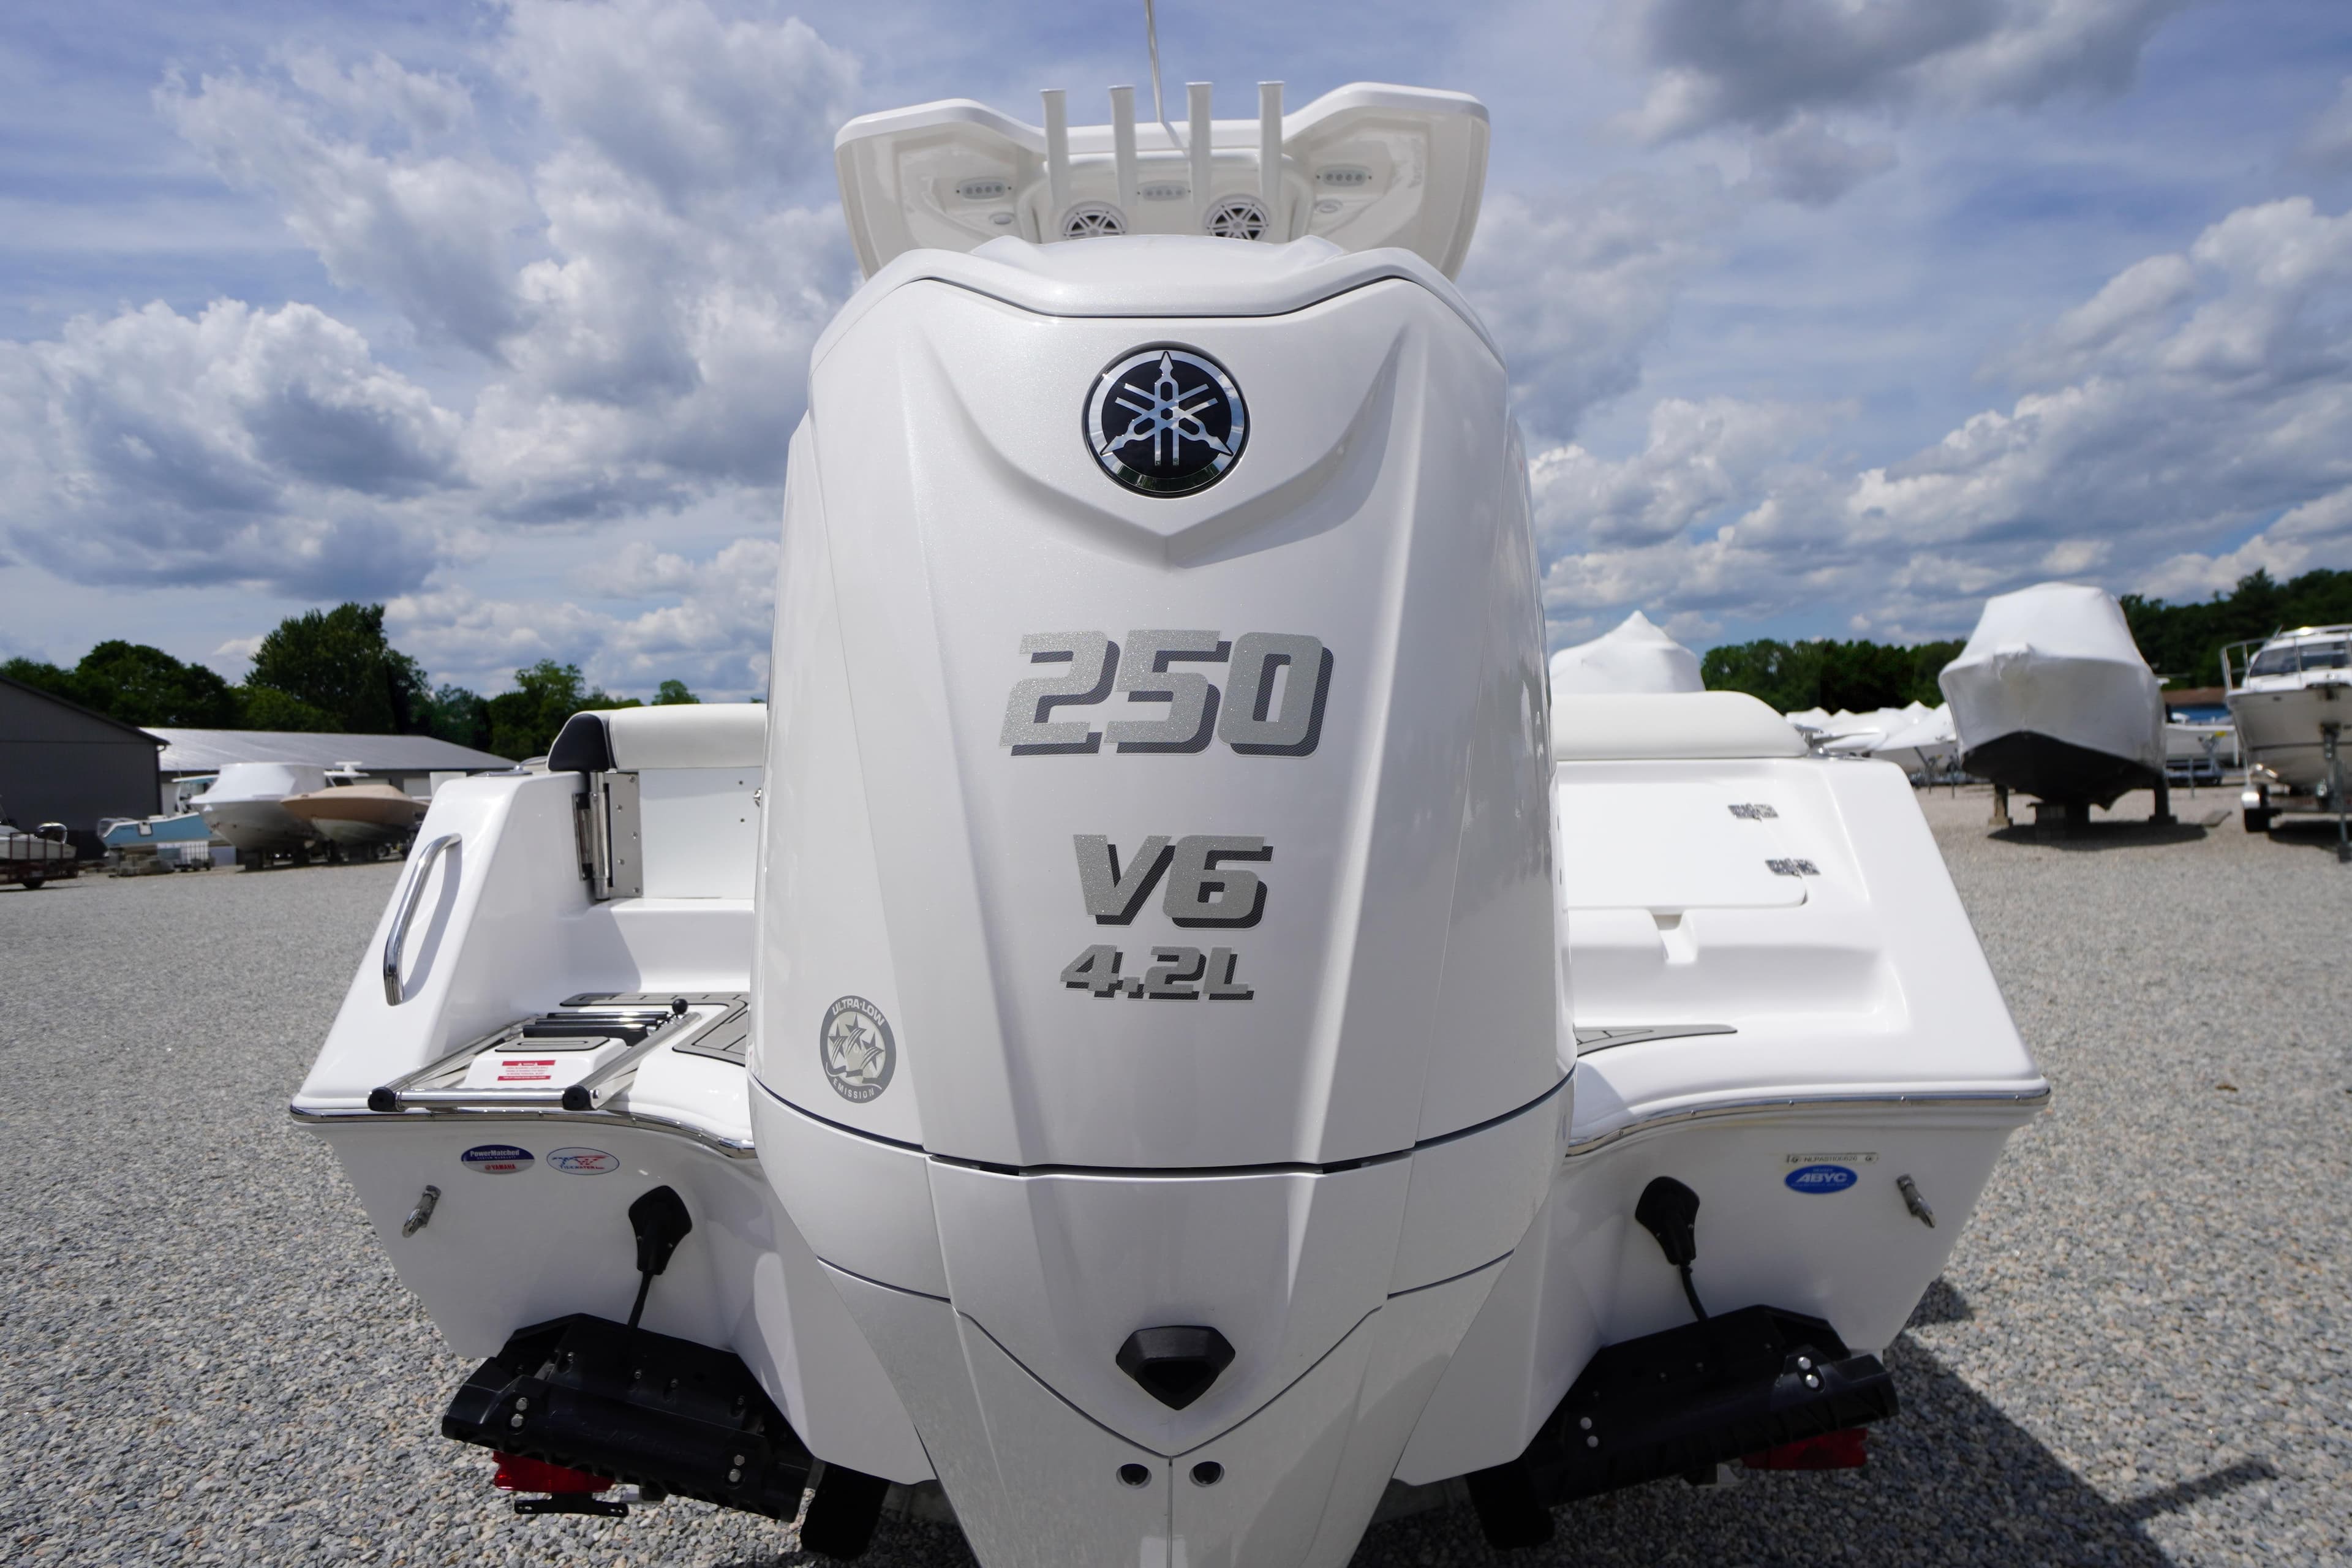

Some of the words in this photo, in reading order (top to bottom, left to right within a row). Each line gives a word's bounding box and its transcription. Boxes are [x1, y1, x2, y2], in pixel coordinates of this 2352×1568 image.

[999, 629, 1334, 757] 250
[1073, 834, 1274, 929] V6
[1060, 944, 1254, 1001] 4.2L
[833, 1077, 874, 1099] EMISSION
[1796, 1172, 1848, 1183] ABYC
